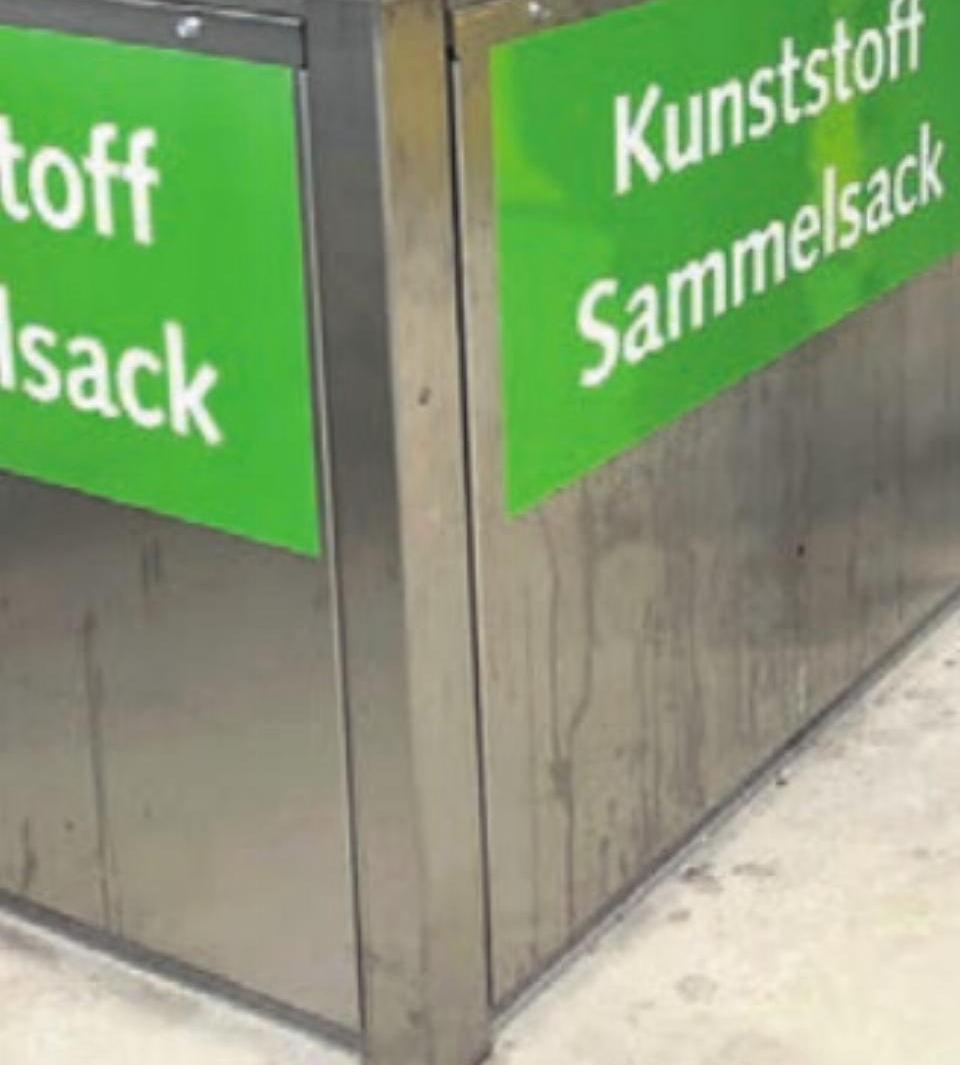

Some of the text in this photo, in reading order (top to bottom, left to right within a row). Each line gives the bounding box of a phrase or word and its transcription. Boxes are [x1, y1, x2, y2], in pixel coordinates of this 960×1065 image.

[0, 113, 160, 246] toff
[576, 122, 945, 388] Sammelsack
[0, 284, 223, 447] lsack
